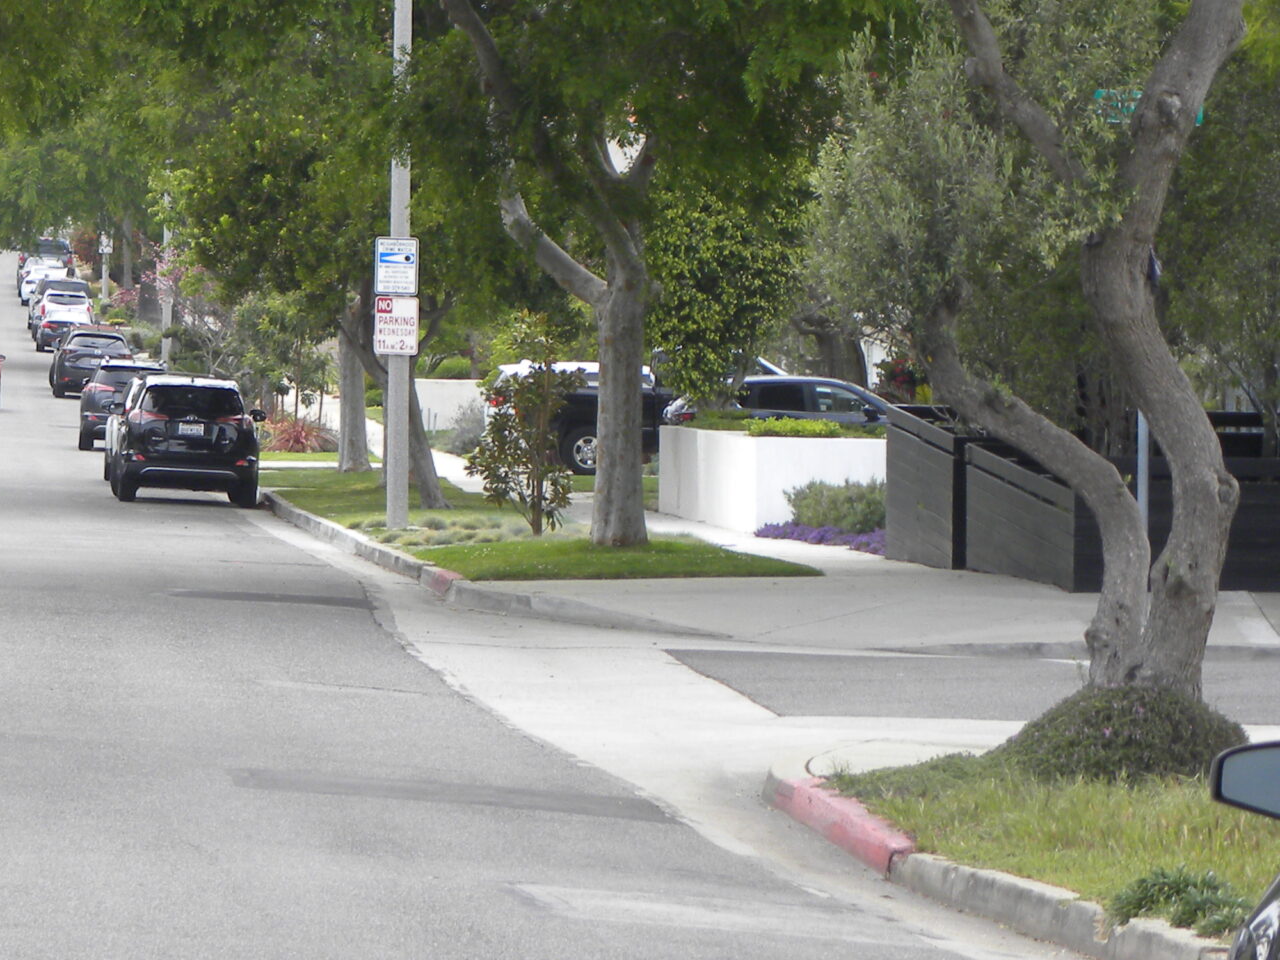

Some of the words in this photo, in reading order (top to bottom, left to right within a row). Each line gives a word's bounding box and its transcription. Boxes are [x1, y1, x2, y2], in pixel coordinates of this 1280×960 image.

[378, 300, 392, 311] NO
[378, 316, 415, 326] PARKING
[378, 328, 415, 336] WEDNESDAY
